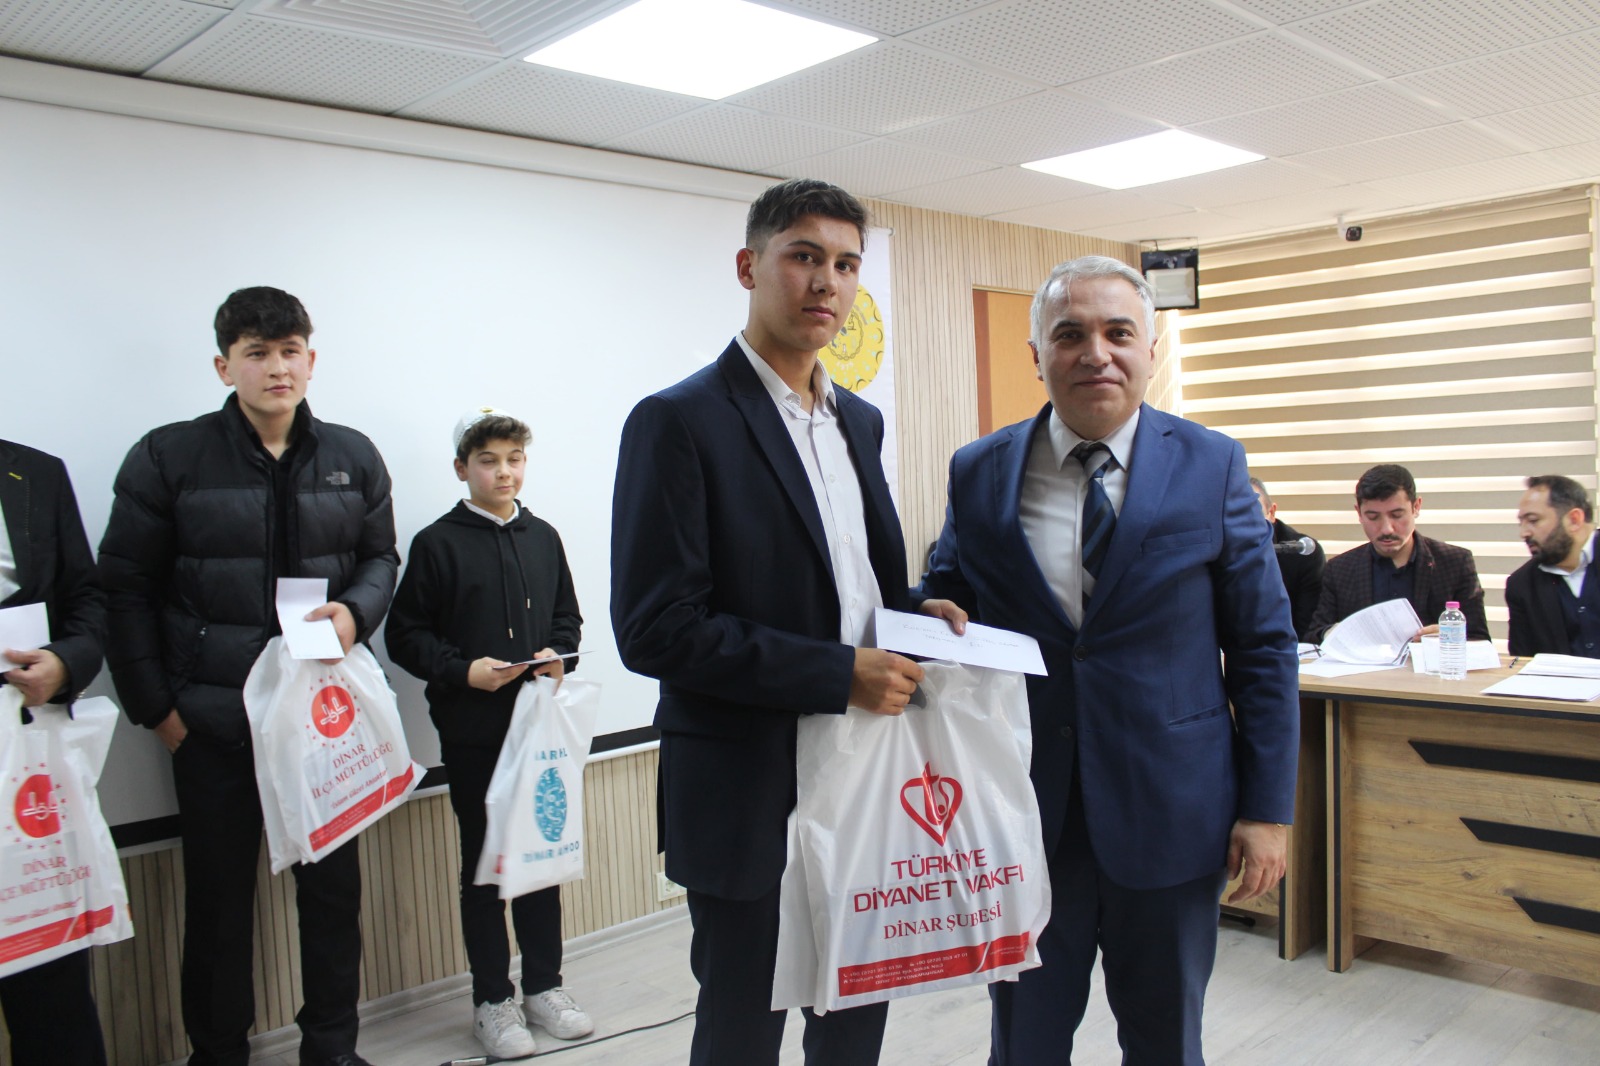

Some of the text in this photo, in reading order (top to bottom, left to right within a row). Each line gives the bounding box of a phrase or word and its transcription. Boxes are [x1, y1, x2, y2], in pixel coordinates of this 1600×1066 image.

[891, 848, 988, 880] TÜRKİYE
[853, 864, 1025, 913] DİYANET VAKFI
[884, 900, 1003, 940] DİNAR ŞUBESİ
